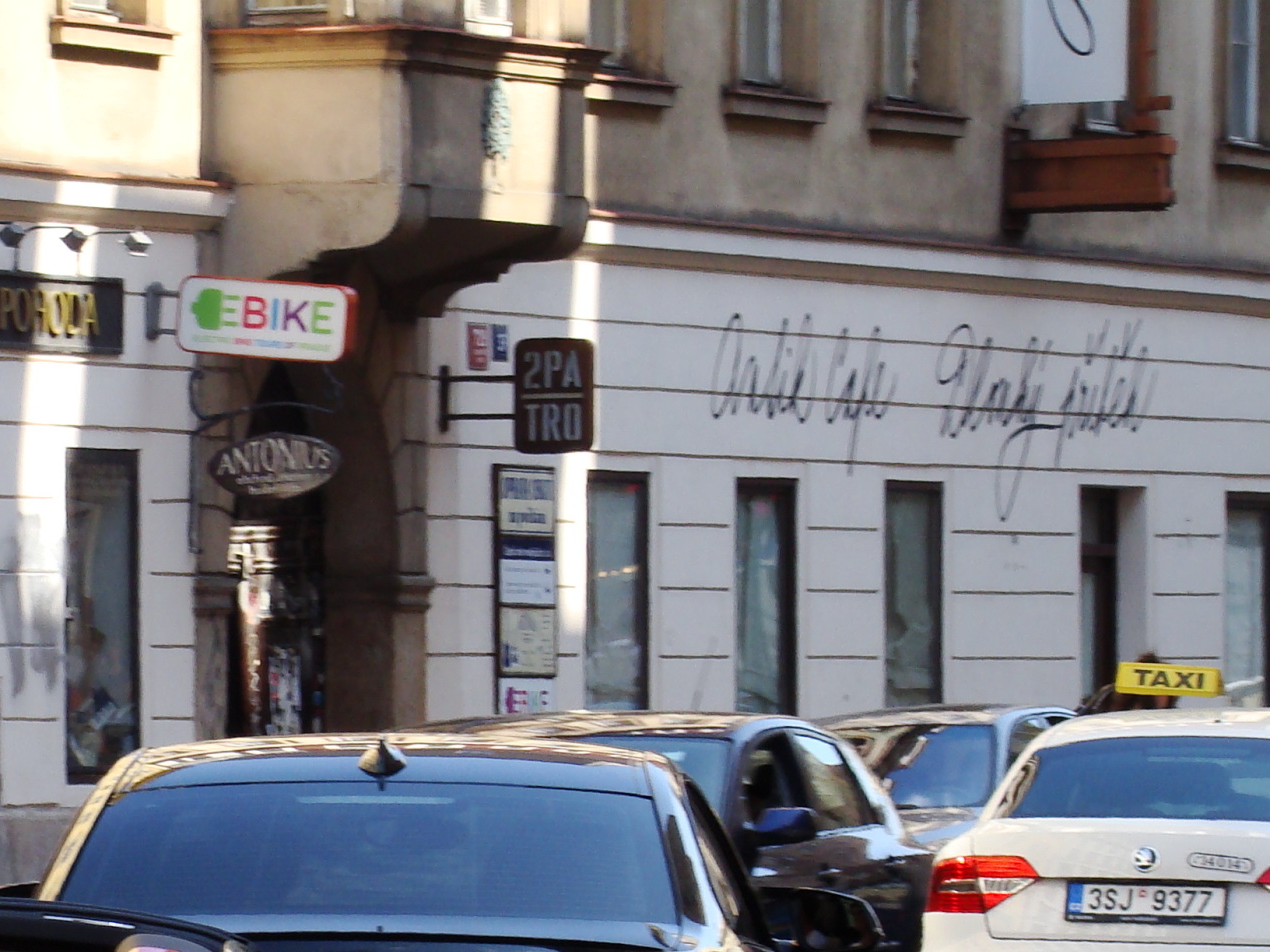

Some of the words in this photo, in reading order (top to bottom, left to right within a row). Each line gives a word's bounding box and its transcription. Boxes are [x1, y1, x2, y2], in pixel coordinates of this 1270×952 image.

[220, 295, 335, 335] EBIKE
[523, 350, 583, 390] 2PA
[523, 402, 583, 441] TRO
[1134, 667, 1206, 691] TAXI
[1089, 888, 1133, 911] 3SJ
[1151, 890, 1214, 913] 9377
